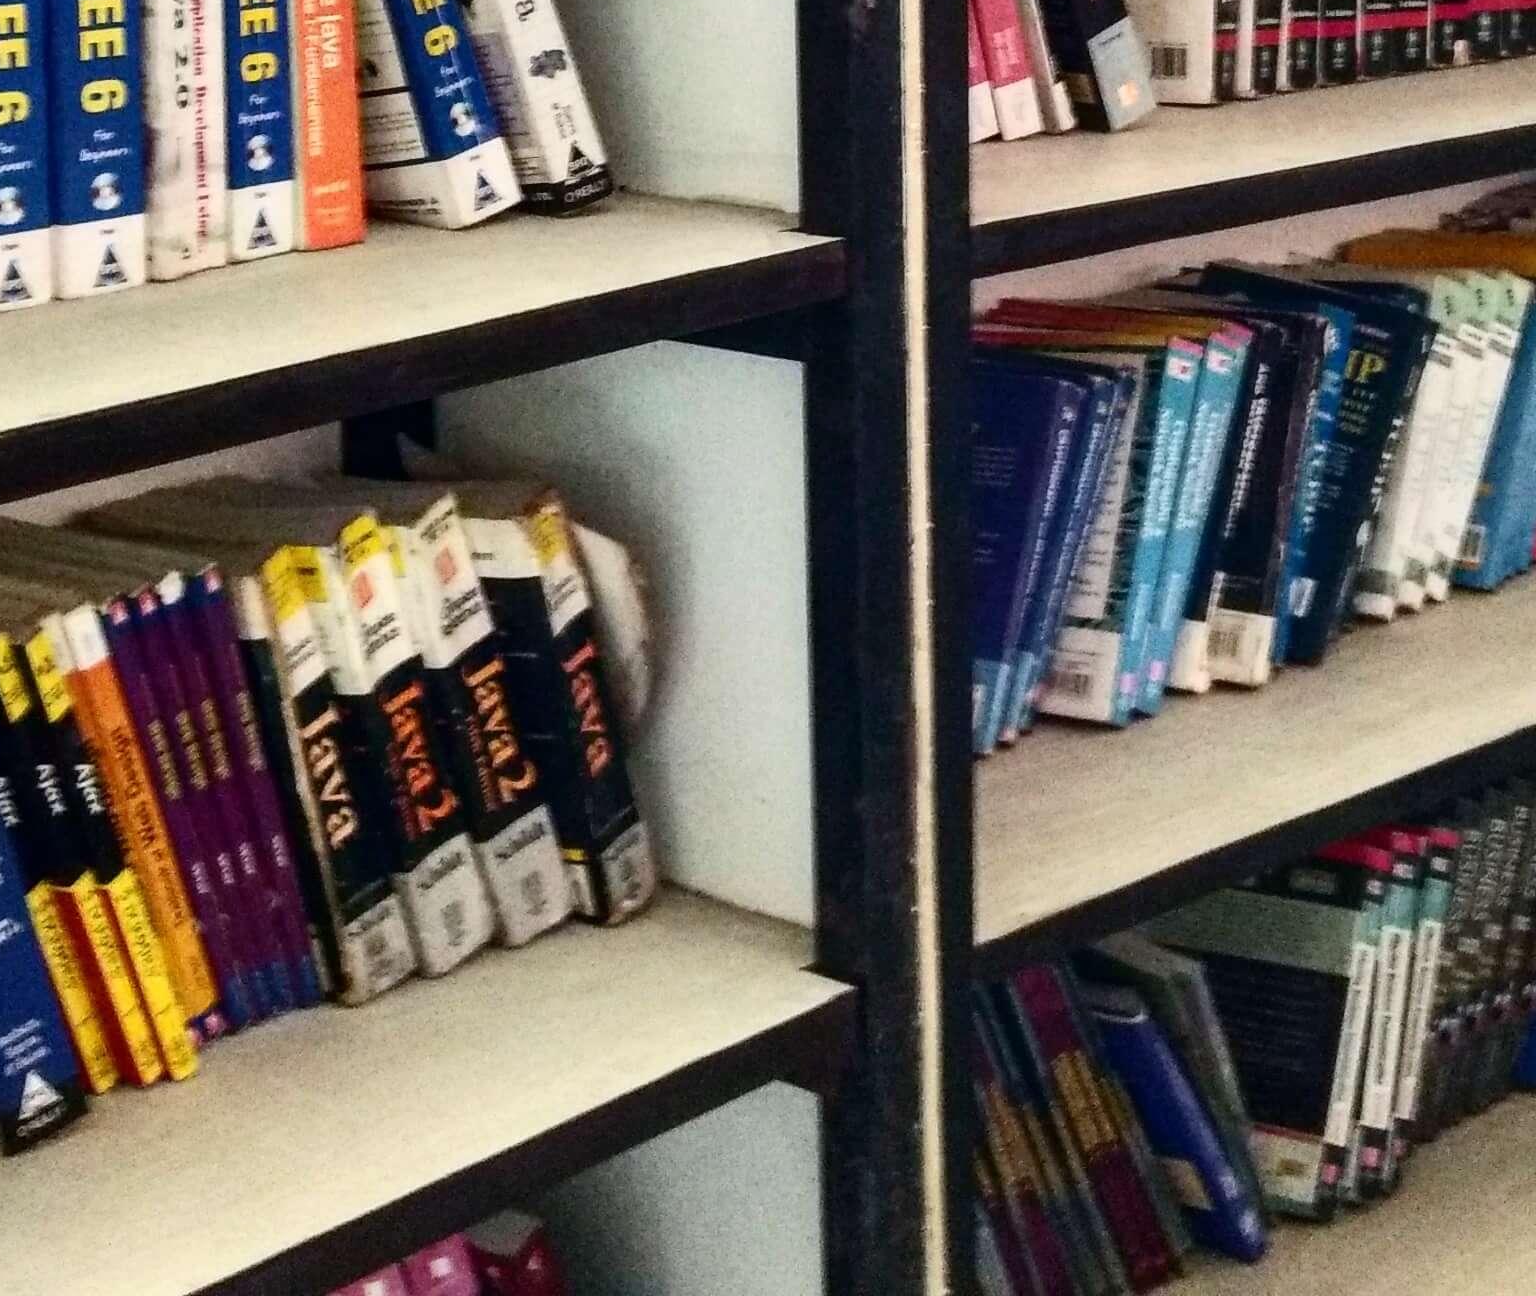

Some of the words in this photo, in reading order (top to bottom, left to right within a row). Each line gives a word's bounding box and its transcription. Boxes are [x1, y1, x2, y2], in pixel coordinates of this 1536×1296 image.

[240, 51, 279, 83] 6
[312, 14, 345, 69] Java
[423, 24, 459, 58] 6
[80, 78, 130, 115] 6
[463, 655, 520, 769] Java
[498, 759, 540, 803] 2
[561, 639, 614, 778] Java
[301, 700, 360, 851] Java
[379, 678, 438, 796] Java
[416, 789, 458, 835] 2
[34, 764, 68, 816] Ajax
[73, 764, 106, 816] Ajax
